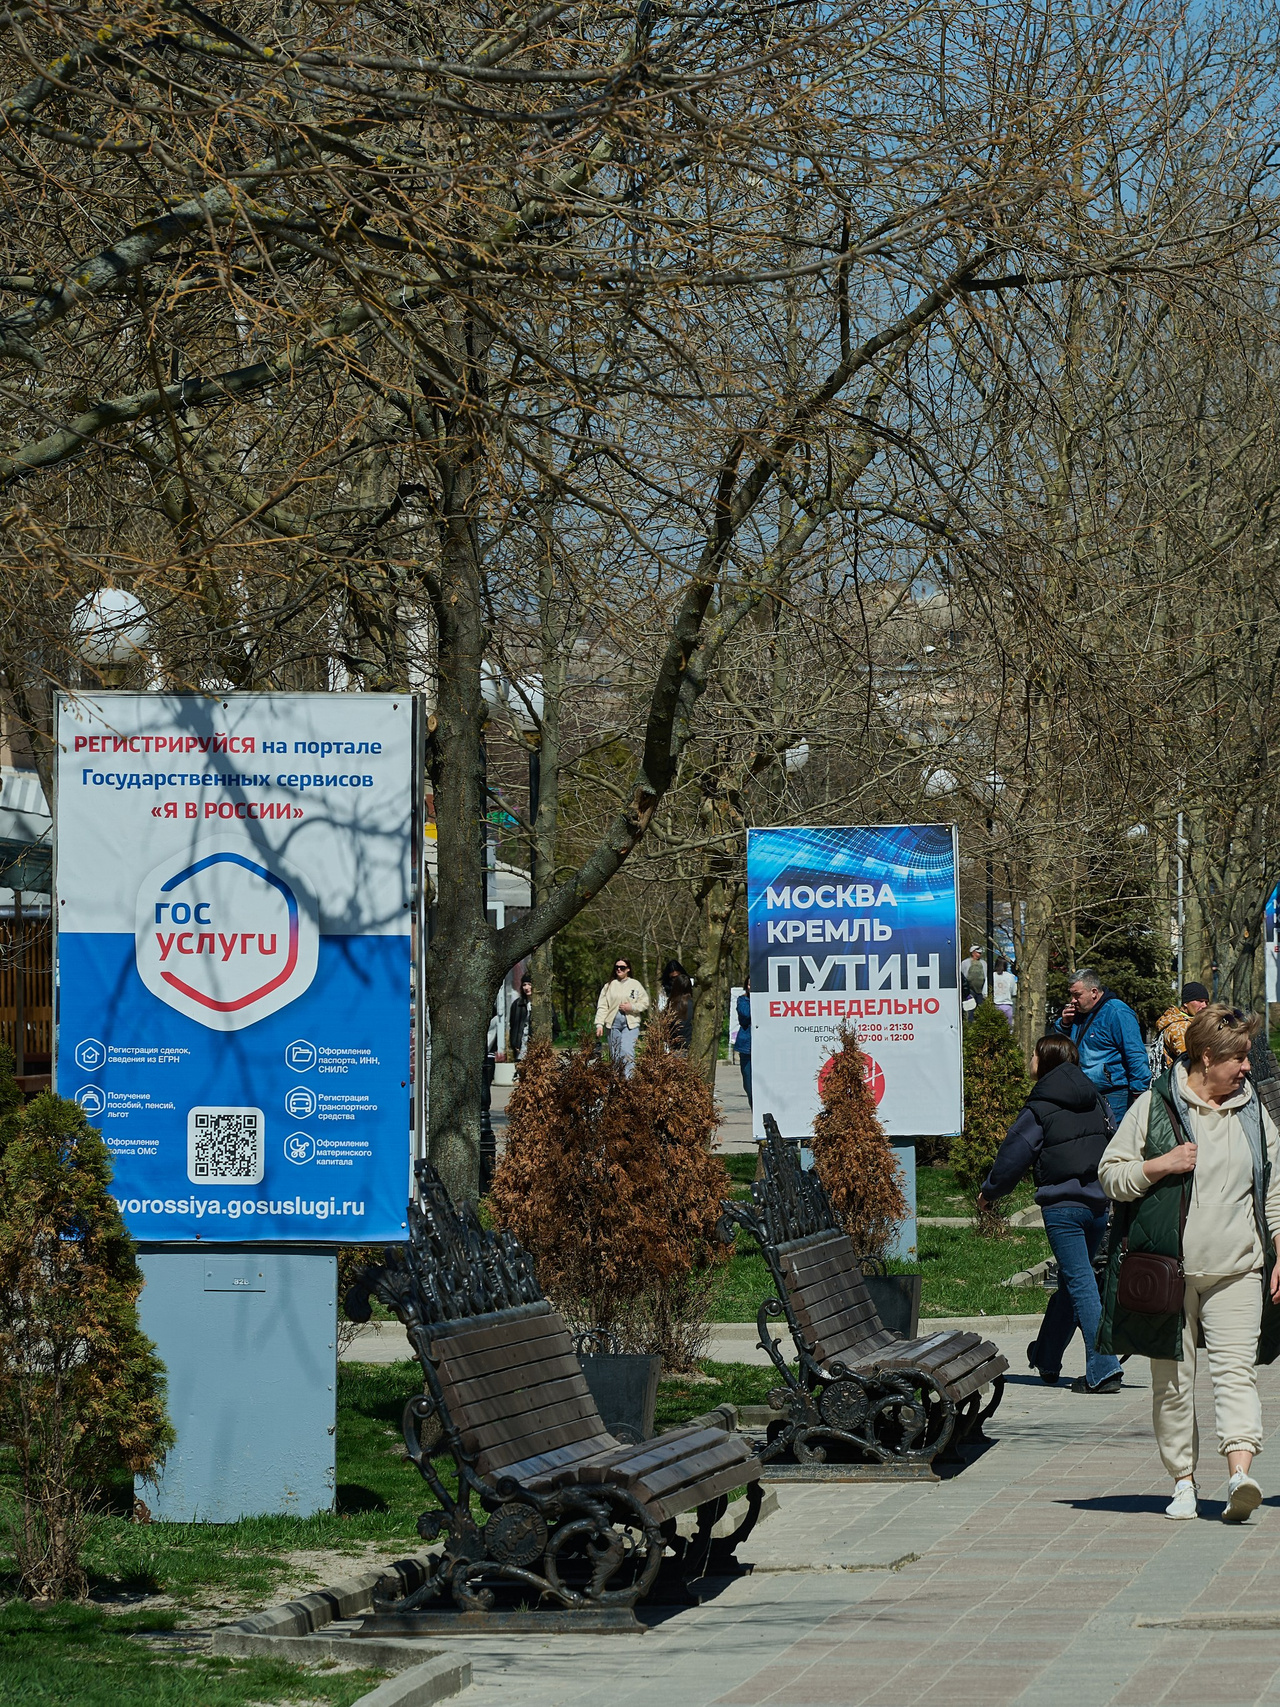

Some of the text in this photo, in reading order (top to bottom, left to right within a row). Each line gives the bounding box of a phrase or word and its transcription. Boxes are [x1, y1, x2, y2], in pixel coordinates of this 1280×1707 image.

[74, 732, 382, 758] РЕГИСТРИРУЙСЯ на портале
[82, 768, 374, 791] Государственных сервисов
[150, 802, 304, 819] «Я В РОССИИ»
[766, 883, 898, 910] МОСКВА
[767, 918, 893, 944] КРЕМЛЬ
[767, 953, 940, 993] ПУТИН
[769, 997, 941, 1019] ЕЖЕНЕДЕЛЬНО
[857, 1023, 882, 1032] 12:00
[889, 1023, 914, 1031] 21:30
[857, 1034, 883, 1042] 07:00
[890, 1033, 915, 1041] 12:00
[107, 1046, 191, 1055] Регистрация сделок,
[318, 1047, 371, 1056] Оформление
[107, 1056, 146, 1064] сведения
[318, 1057, 380, 1066] паспорта, ИНН,
[318, 1065, 349, 1073] СНИЛС
[107, 1092, 151, 1101] Получение
[318, 1094, 369, 1103] Регистрация
[107, 1101, 176, 1110] пособий, пенсий,
[318, 1104, 378, 1112] транспортного
[317, 1113, 355, 1121] средства
[107, 1137, 160, 1146] Оформление
[316, 1139, 369, 1148] Оформление
[137, 1147, 158, 1155] ОМС
[316, 1150, 372, 1158] материнского
